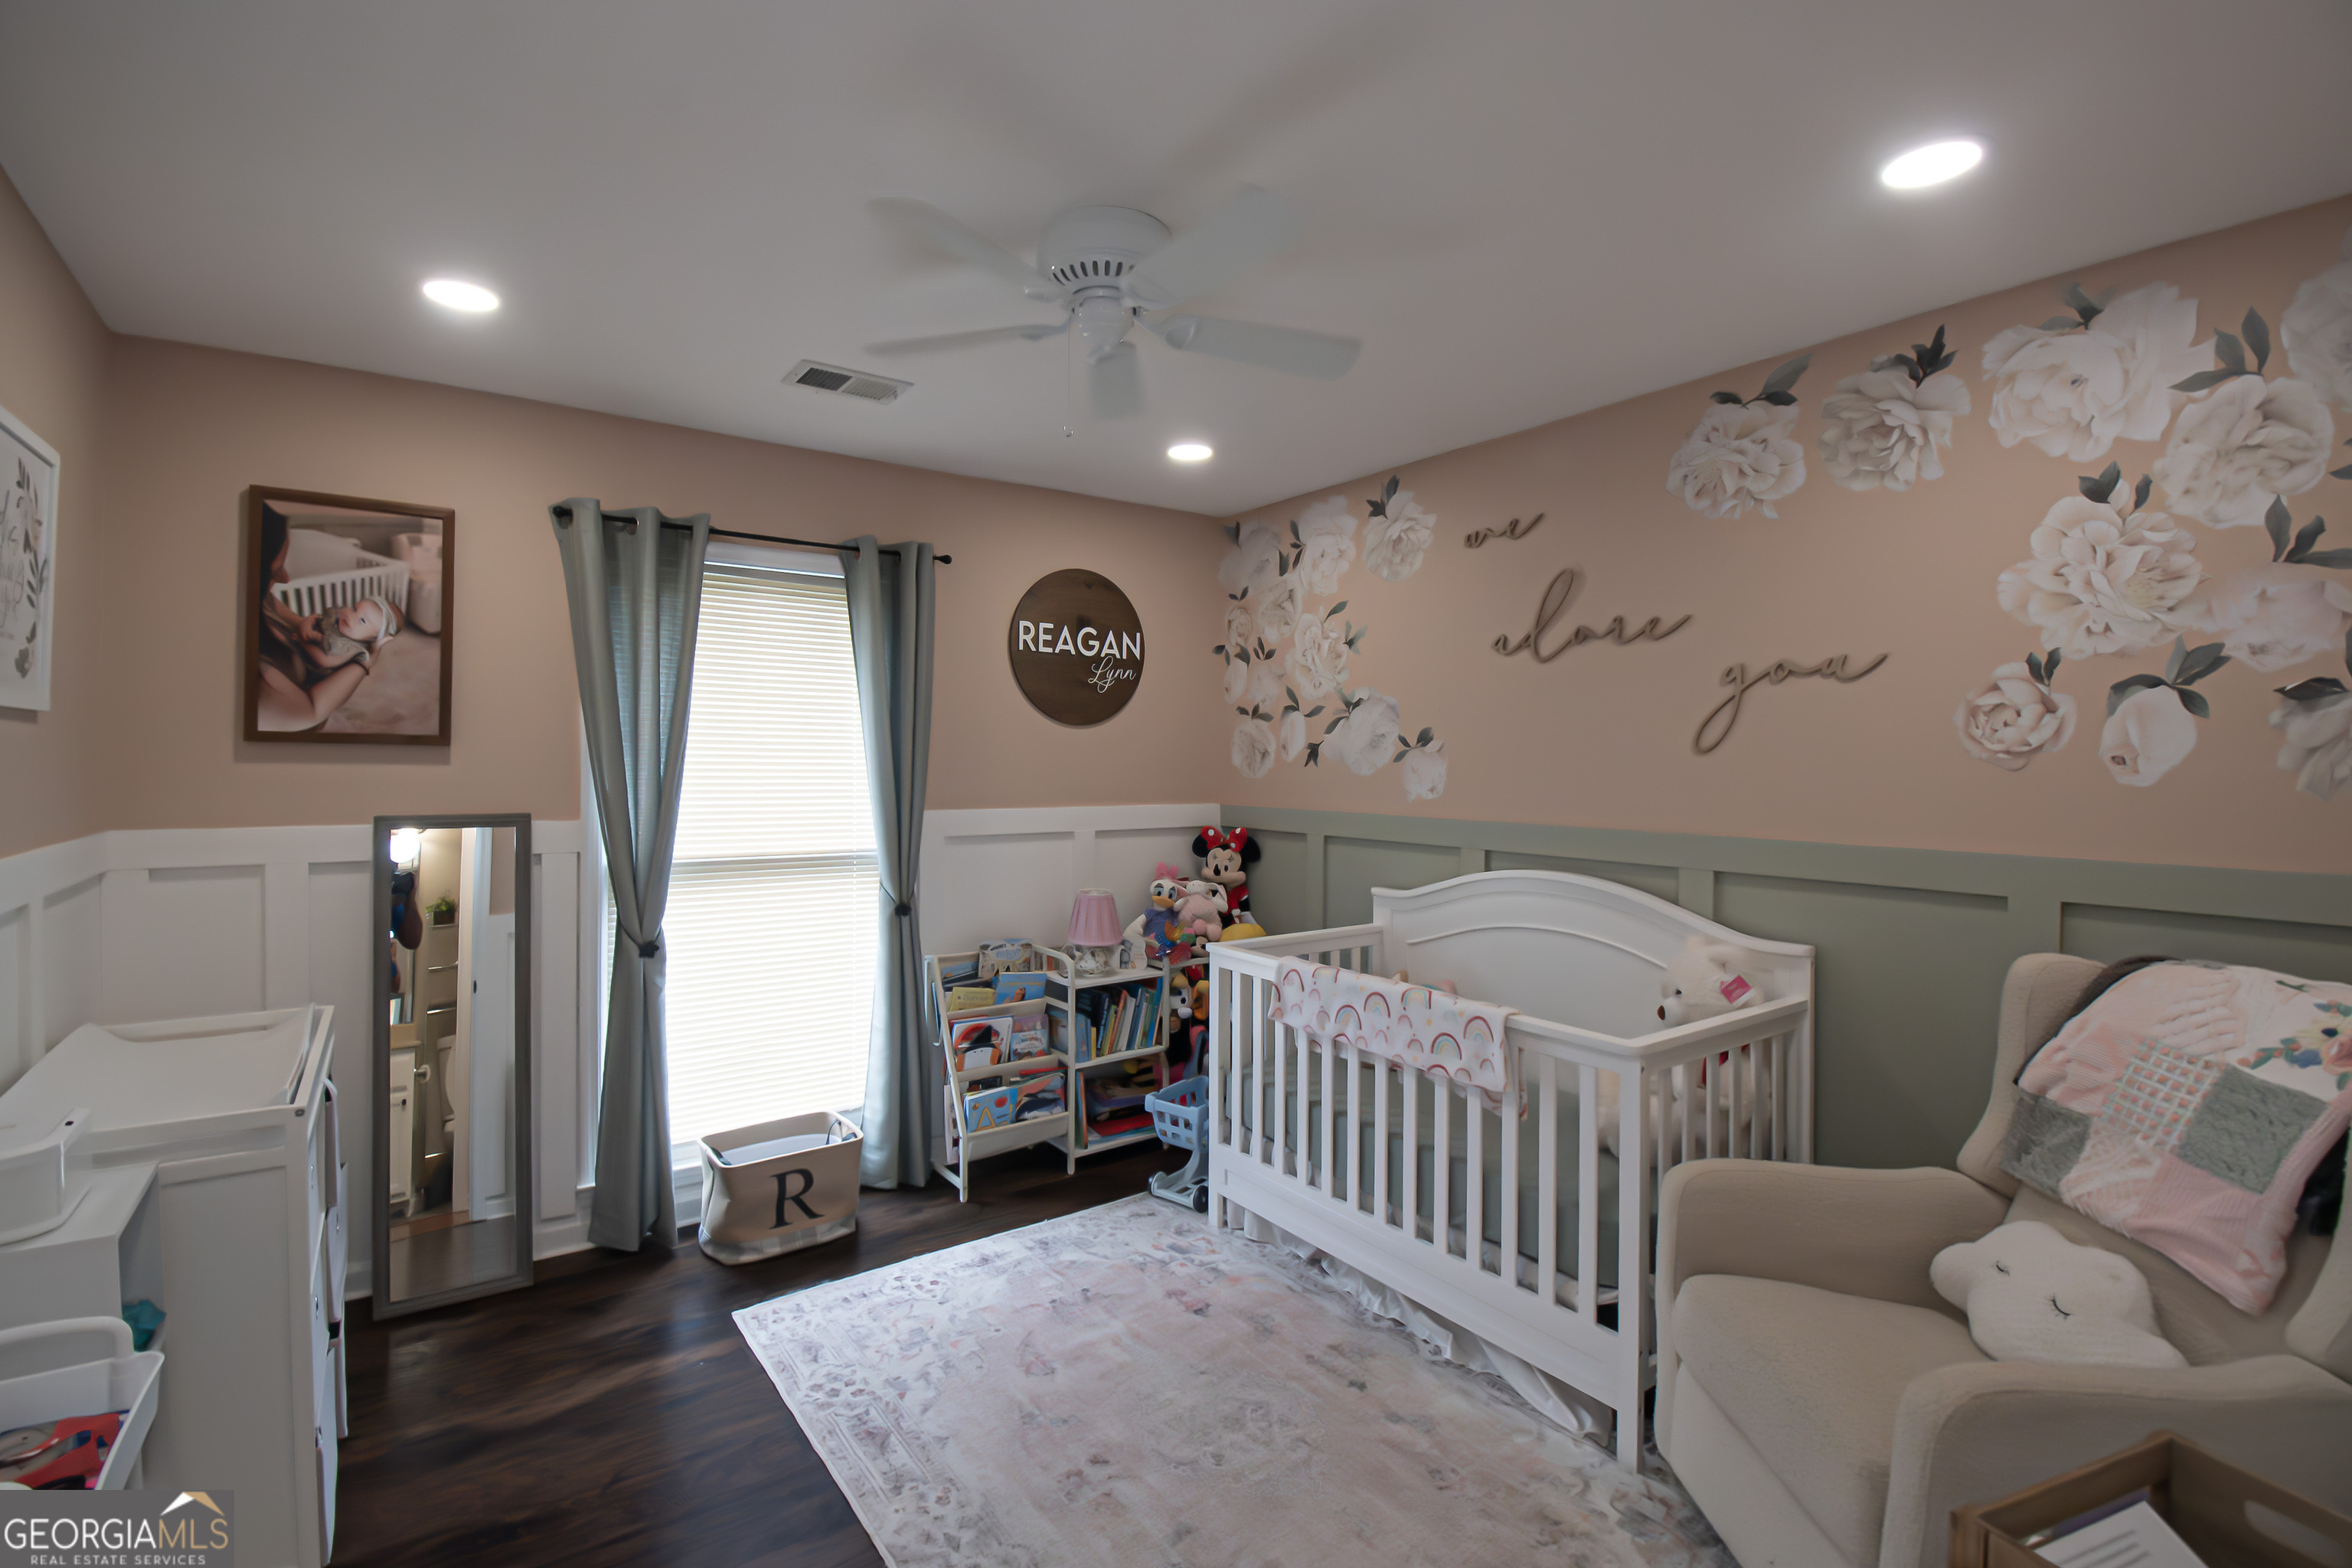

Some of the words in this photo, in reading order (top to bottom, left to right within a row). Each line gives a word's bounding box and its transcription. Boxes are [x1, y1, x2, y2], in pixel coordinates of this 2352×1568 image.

[1018, 620, 1140, 661] REAGAN
[1491, 568, 1694, 664] adore
[1088, 655, 1136, 693] Lynn
[1694, 653, 1890, 755] you
[769, 1168, 825, 1230] R
